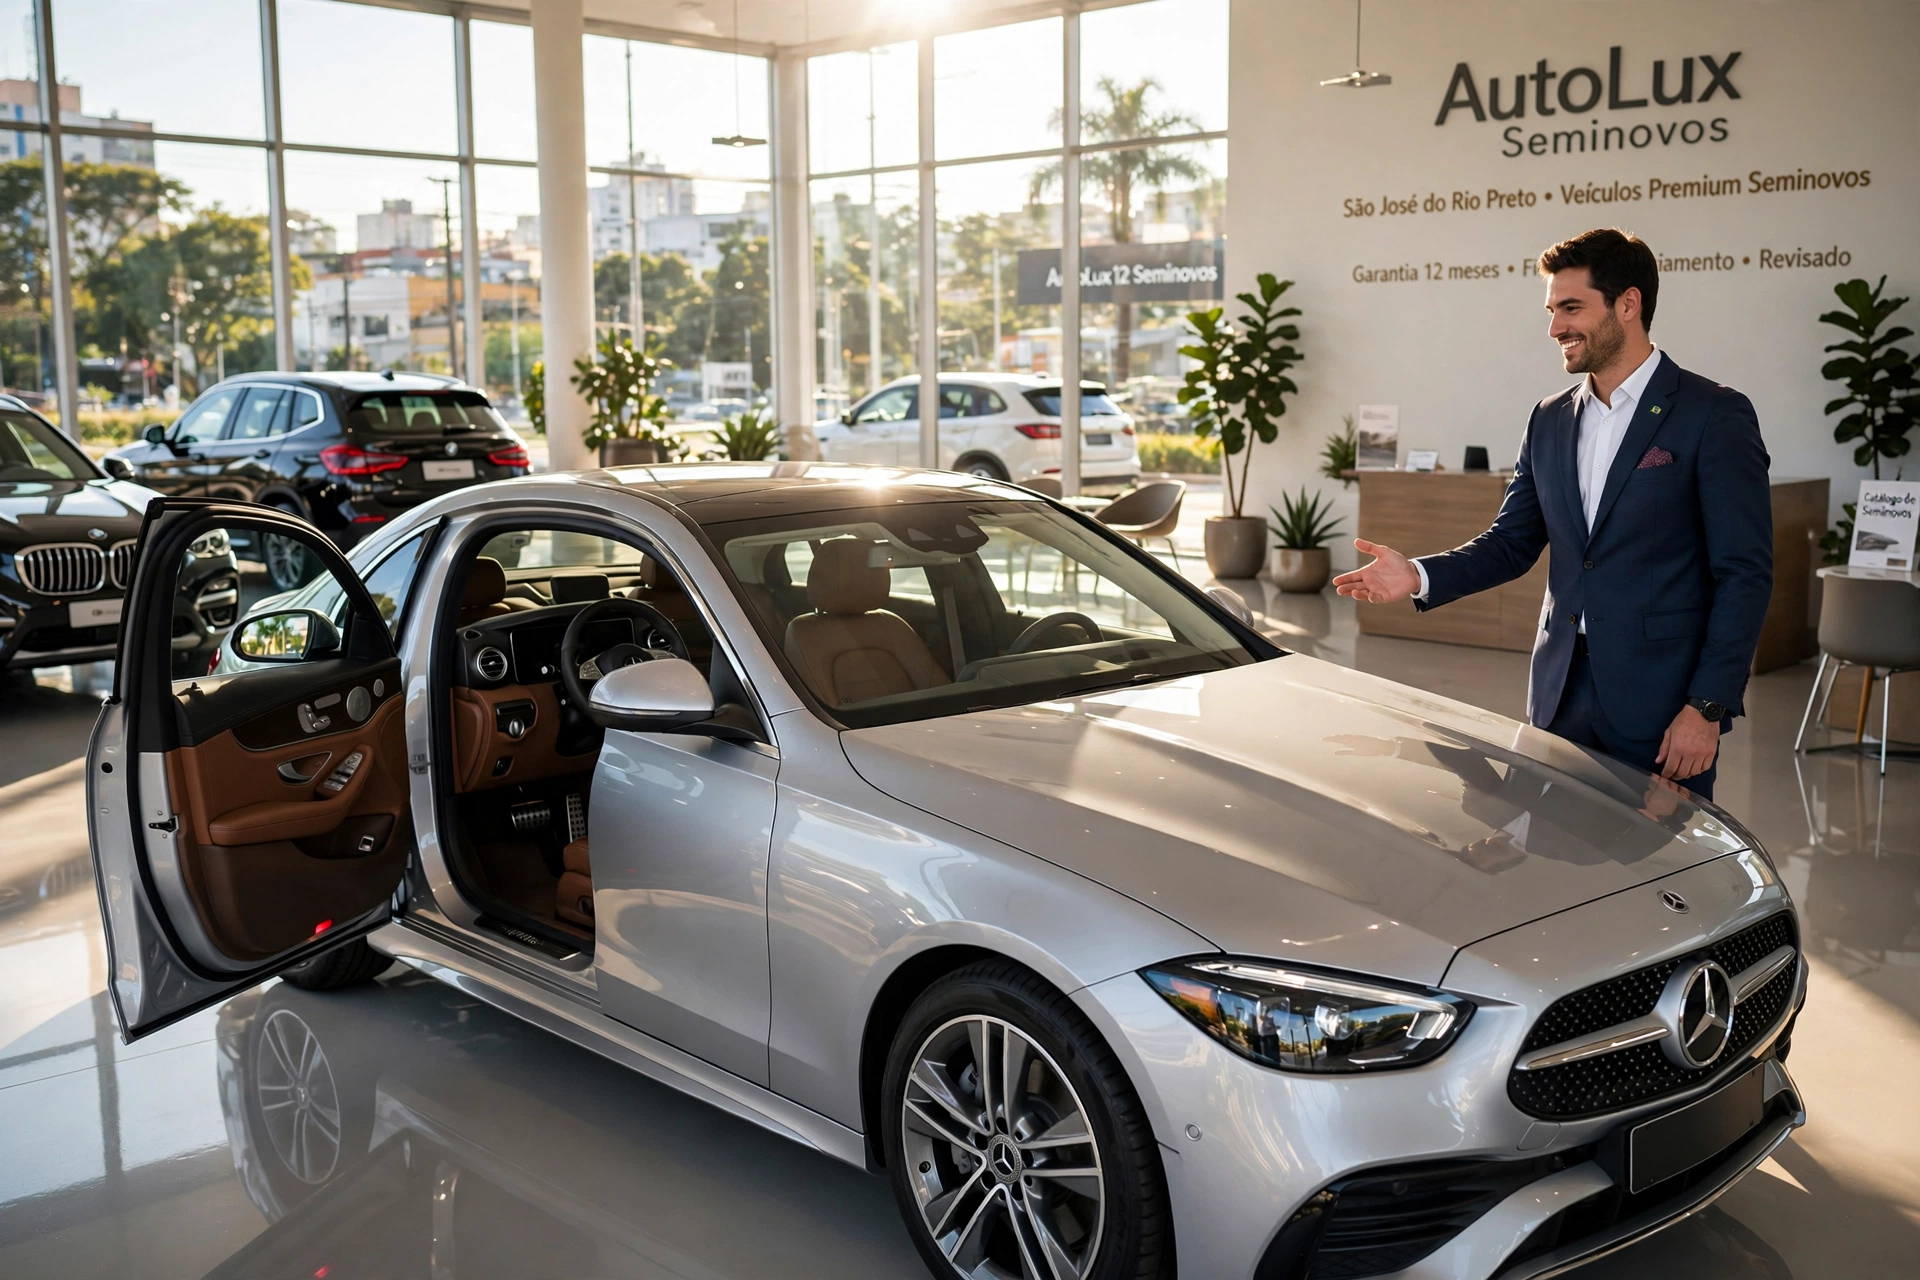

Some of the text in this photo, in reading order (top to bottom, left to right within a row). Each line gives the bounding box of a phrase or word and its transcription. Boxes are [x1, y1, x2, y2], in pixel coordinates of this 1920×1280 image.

[1434, 45, 1743, 126] AutoLux
[1502, 117, 1729, 158] Seminovos
[1343, 168, 1871, 218] São José do Rio Preto Veículos Premium Seminovos
[1045, 265, 1112, 288] ALux
[1132, 261, 1219, 285] Seminovos
[1352, 264, 1419, 284] Garantia
[1424, 262, 1443, 281] 12
[1448, 262, 1500, 280] meses
[1759, 244, 1852, 270] Revisado
